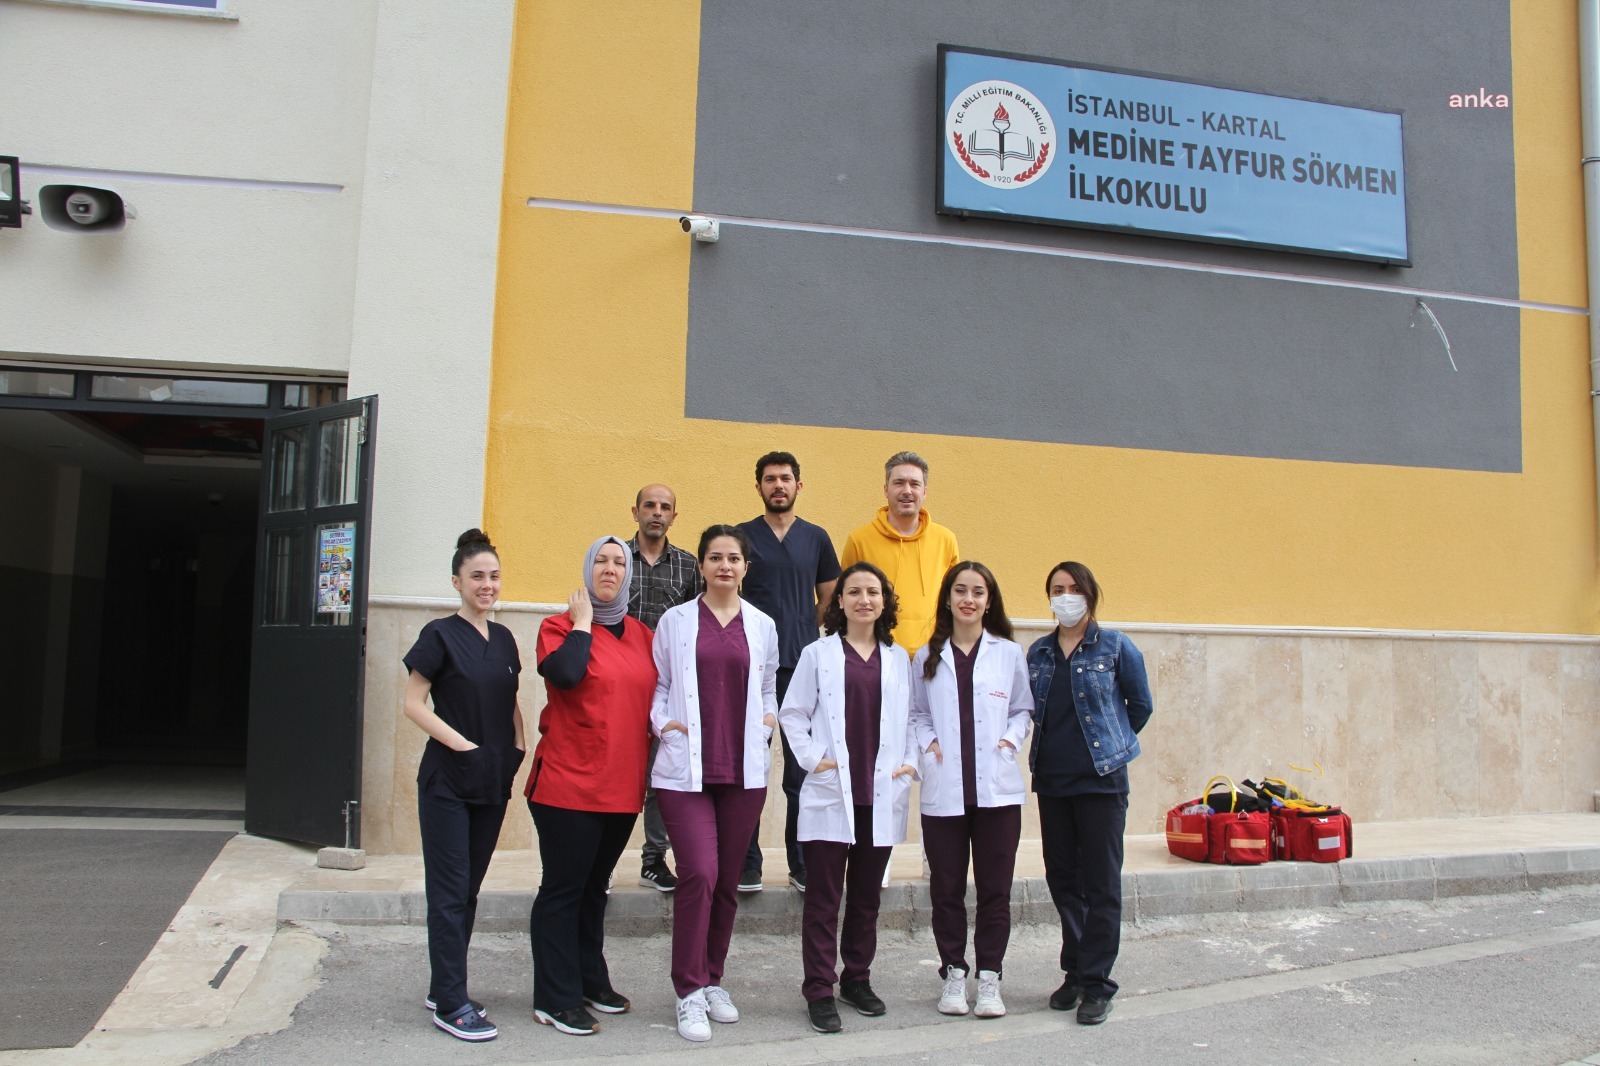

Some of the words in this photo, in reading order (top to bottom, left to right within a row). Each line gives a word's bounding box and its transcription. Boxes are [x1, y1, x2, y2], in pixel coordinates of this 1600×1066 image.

[955, 111, 965, 124] T.C.
[962, 91, 982, 110] MİLLİ
[982, 86, 1013, 97] EĞİTİM
[1014, 93, 1047, 135] BAKANLIĞI
[1068, 88, 1180, 127] İSTANBUL
[1202, 111, 1287, 141] KARTAL
[993, 175, 1012, 184] 1920
[1068, 127, 1175, 166] MEDİNE
[1182, 142, 1286, 181] TAYFUR
[1292, 152, 1397, 195] SÖKMEN
[1069, 164, 1207, 213] İLKOKULU
